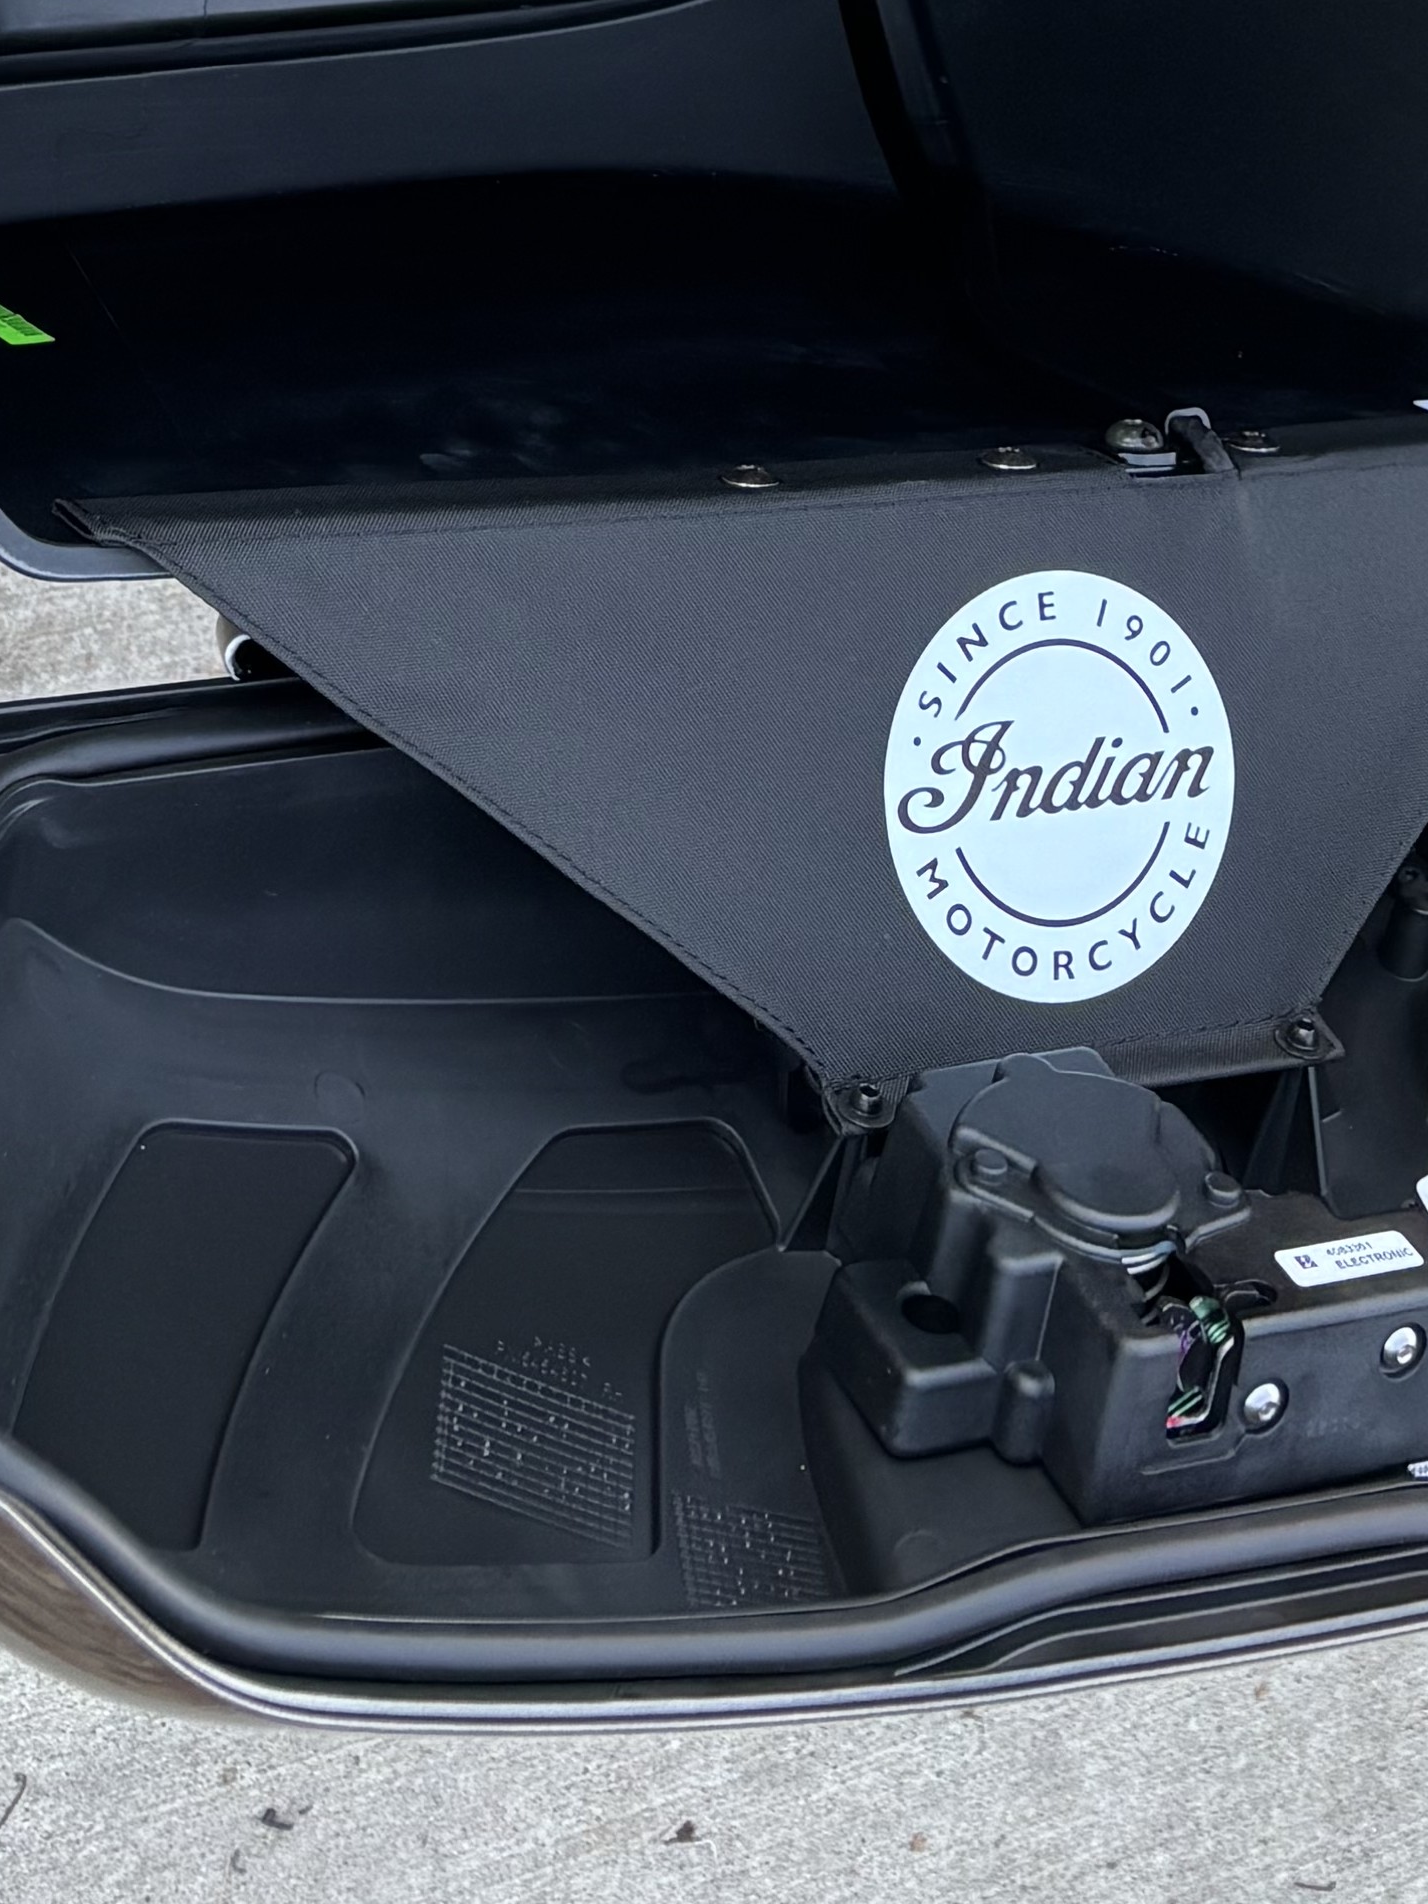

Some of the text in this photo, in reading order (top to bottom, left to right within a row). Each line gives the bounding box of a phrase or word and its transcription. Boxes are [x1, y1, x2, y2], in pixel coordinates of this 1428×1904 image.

[917, 590, 1192, 720] SINCE 1901
[897, 717, 1217, 837] Indian
[915, 820, 1213, 984] MOTORCYCLE
[1335, 1247, 1414, 1270] ELECTRONIC
